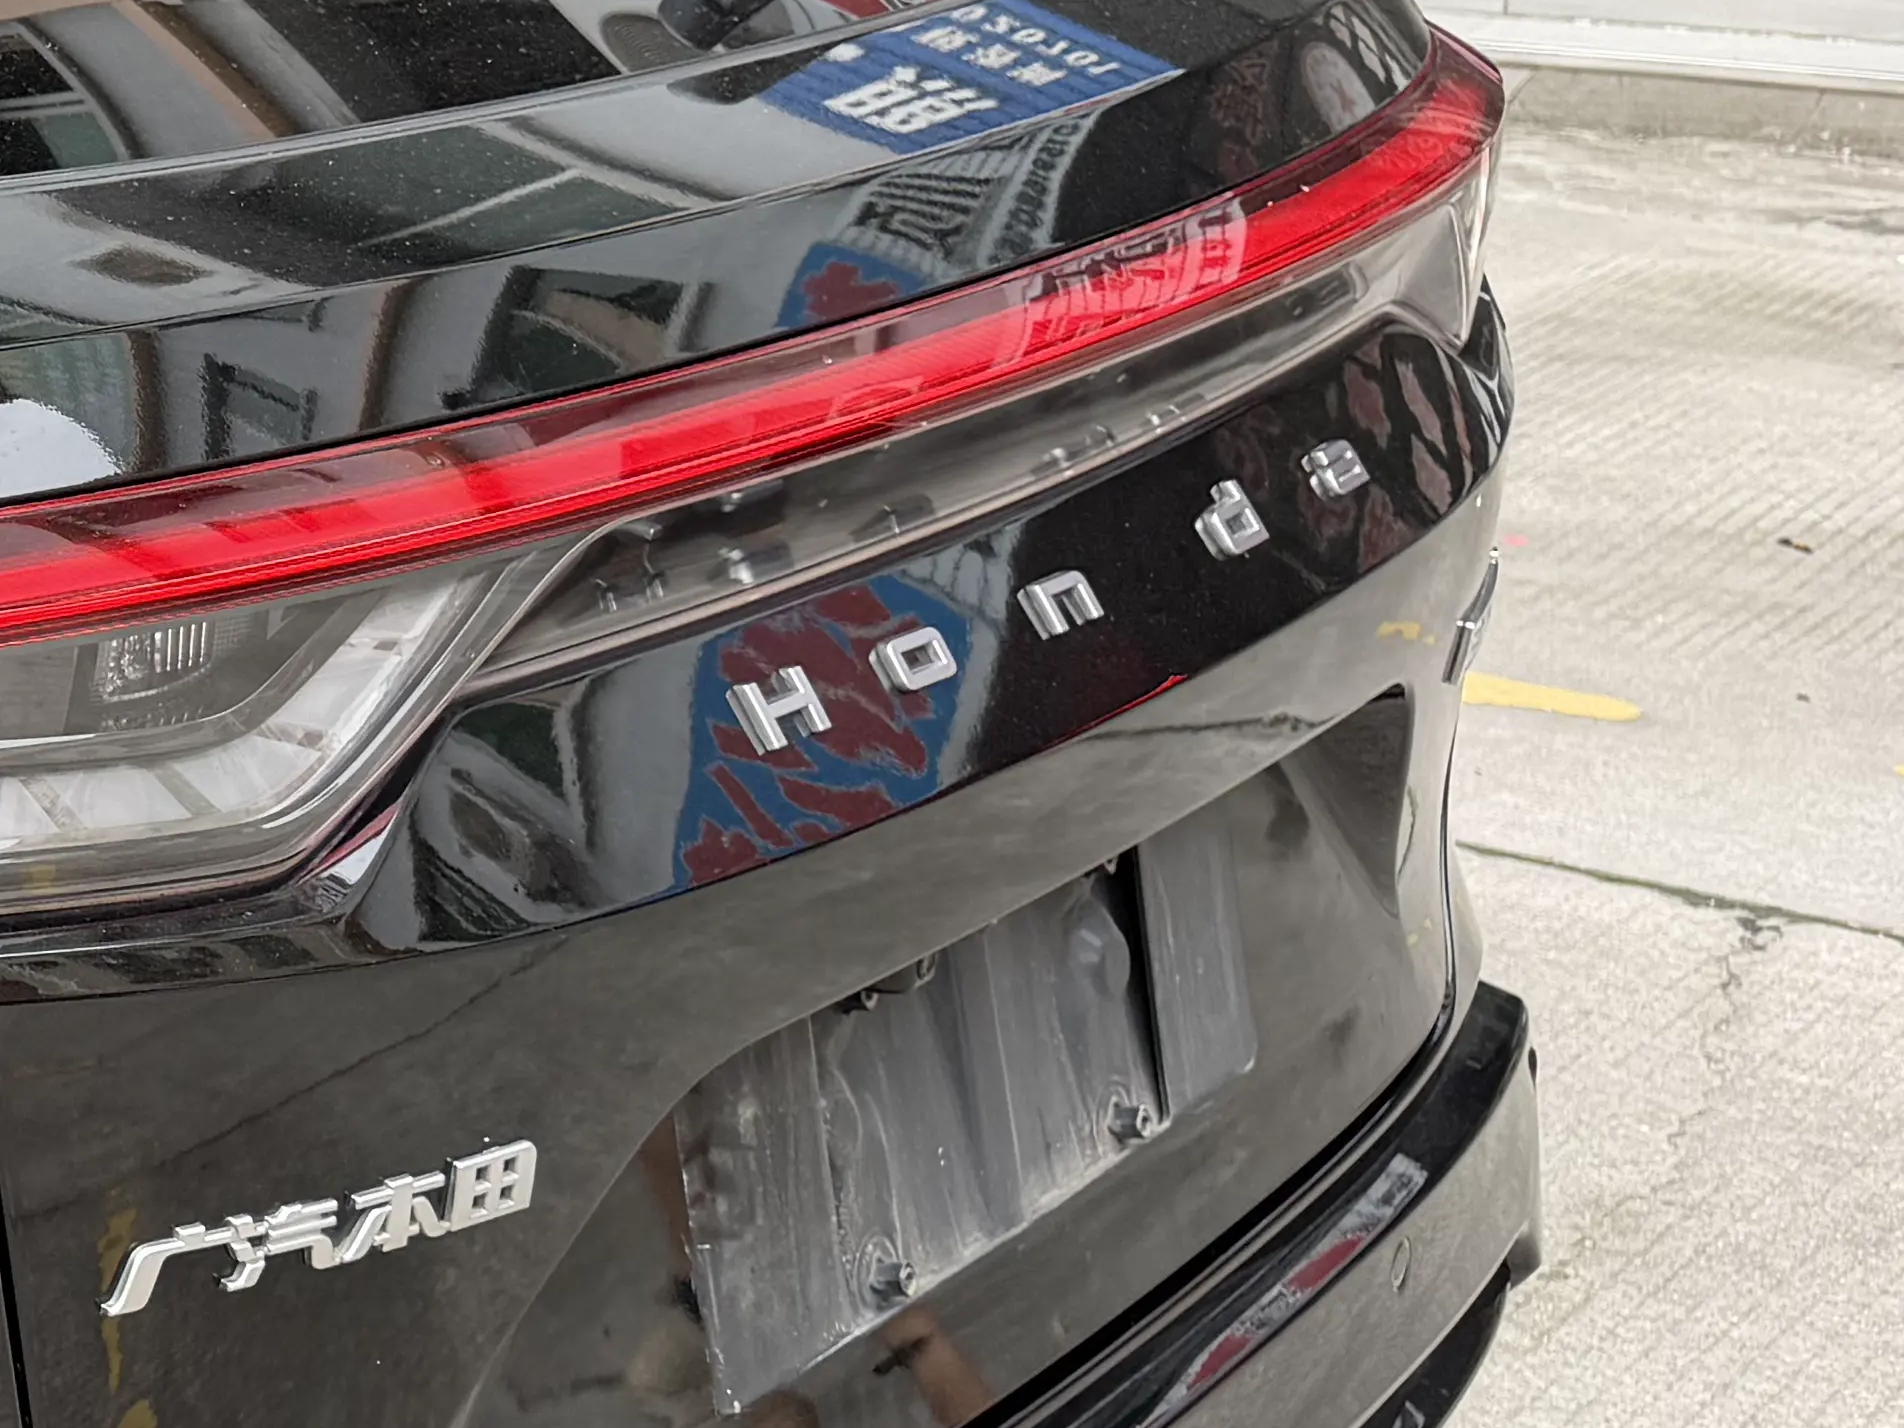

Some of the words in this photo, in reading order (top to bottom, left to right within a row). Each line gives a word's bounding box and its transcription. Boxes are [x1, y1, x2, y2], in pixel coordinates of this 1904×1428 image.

[725, 438, 1370, 757] Honda
[95, 1139, 538, 1318] 广汽本田
